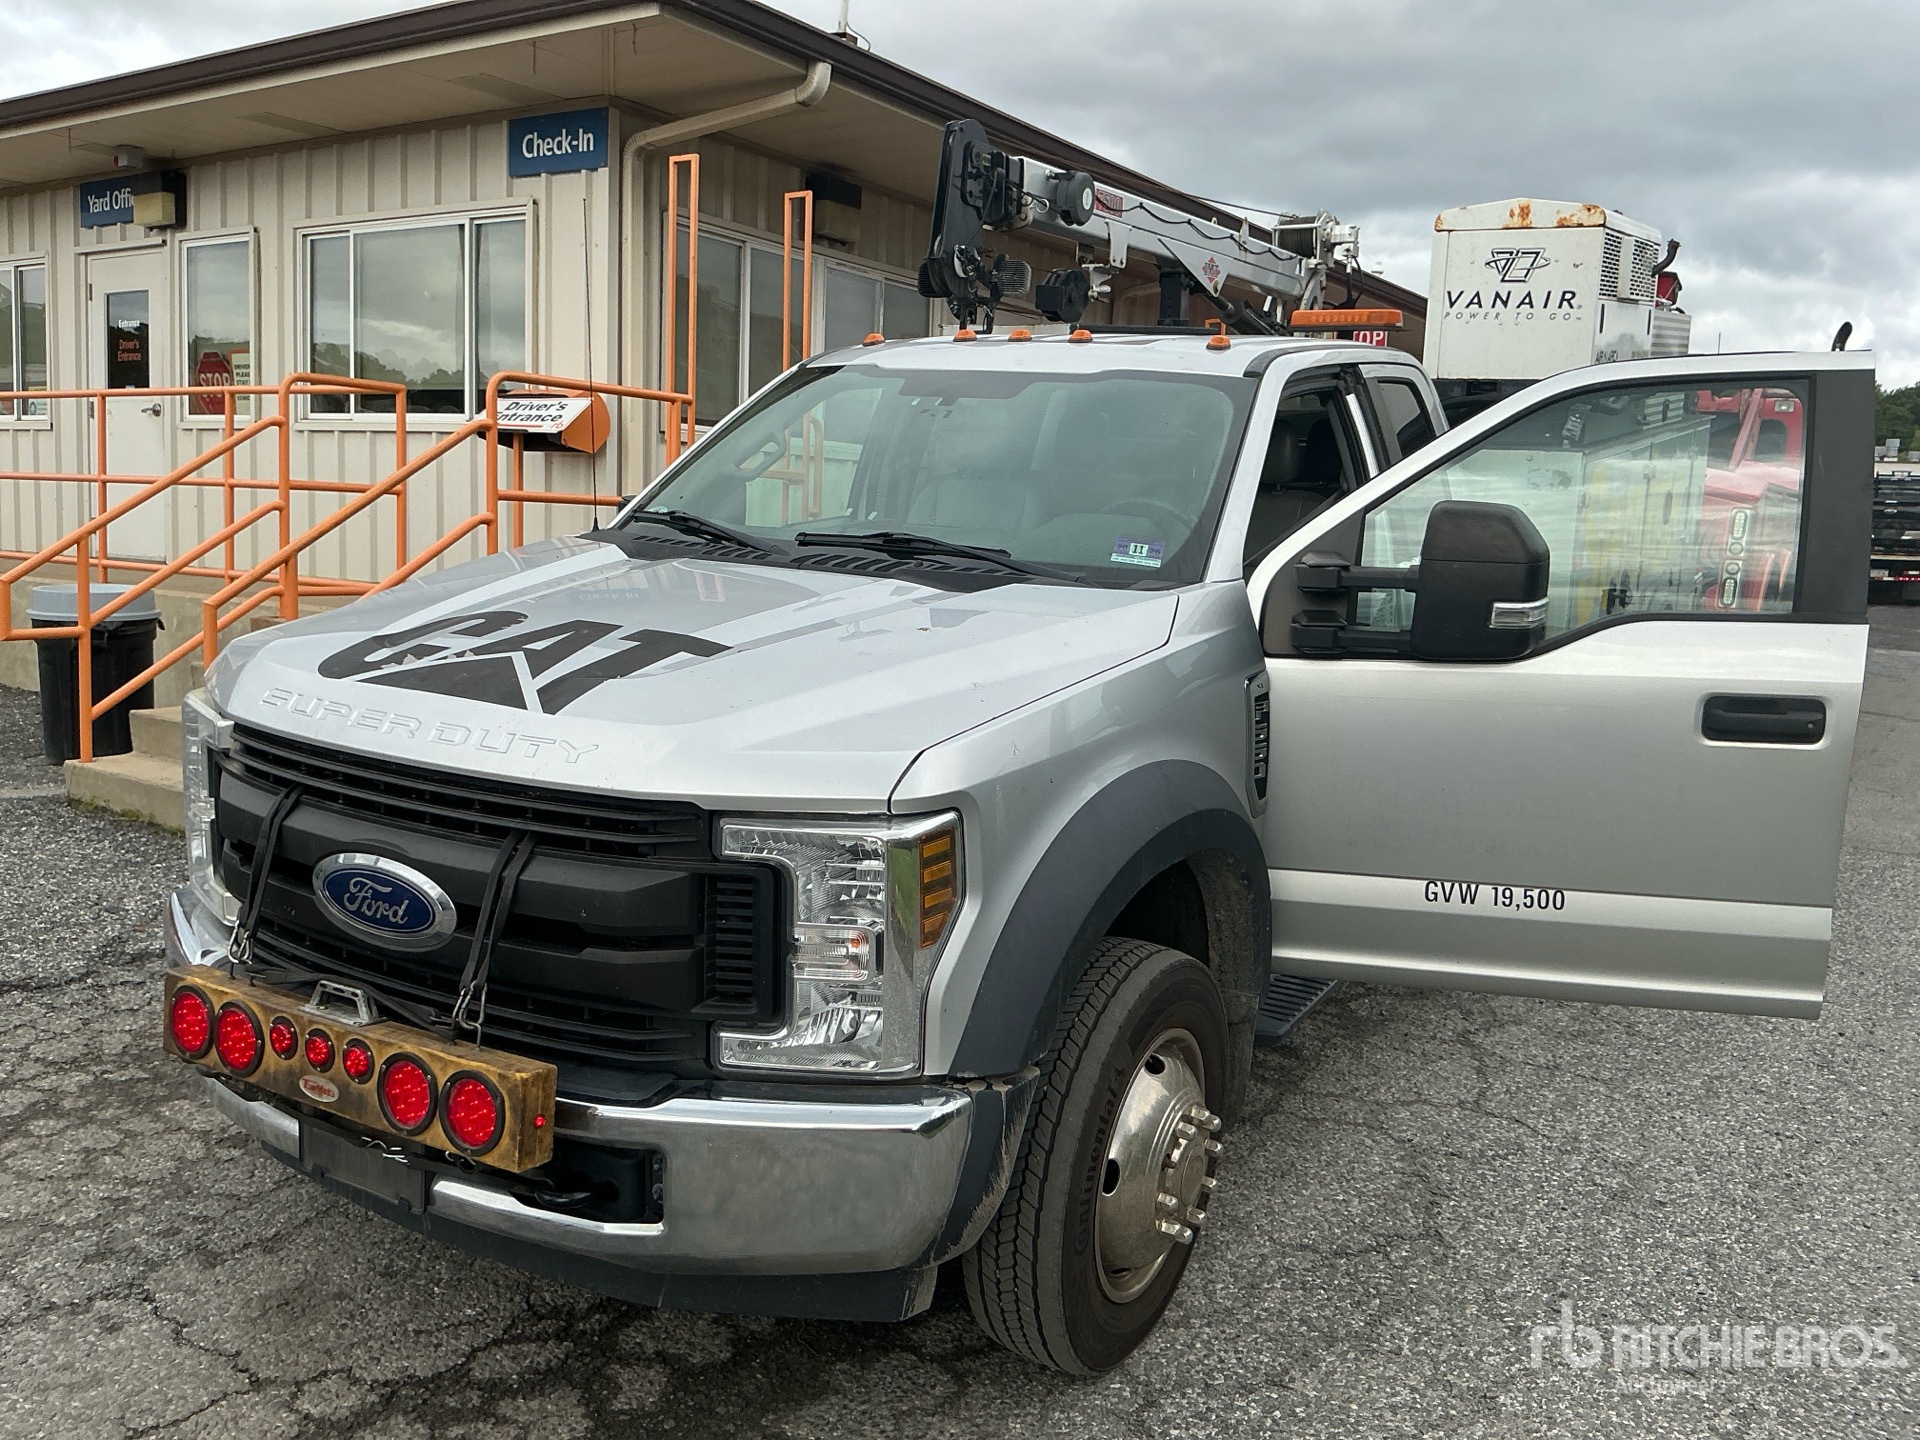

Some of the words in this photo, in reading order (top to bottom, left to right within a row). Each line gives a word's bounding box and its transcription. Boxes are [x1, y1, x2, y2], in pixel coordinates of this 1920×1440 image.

[522, 128, 594, 158] Check-In
[87, 191, 110, 213] Yard
[1446, 290, 1577, 309] VANAIR
[118, 319, 140, 328] Entrance
[1444, 312, 1501, 320] POWER
[1516, 312, 1534, 320] TO
[1549, 312, 1571, 321] GO
[1352, 330, 1385, 346] TOP
[117, 351, 142, 361] Entrance
[200, 371, 231, 398] STOP
[504, 401, 568, 411] Driver's
[318, 610, 734, 716] CAT
[258, 687, 423, 739] SUPER
[426, 720, 600, 764] DUTY
[343, 877, 410, 925] Ford
[1424, 880, 1480, 905] GVW
[1491, 886, 1565, 911] 19,500
